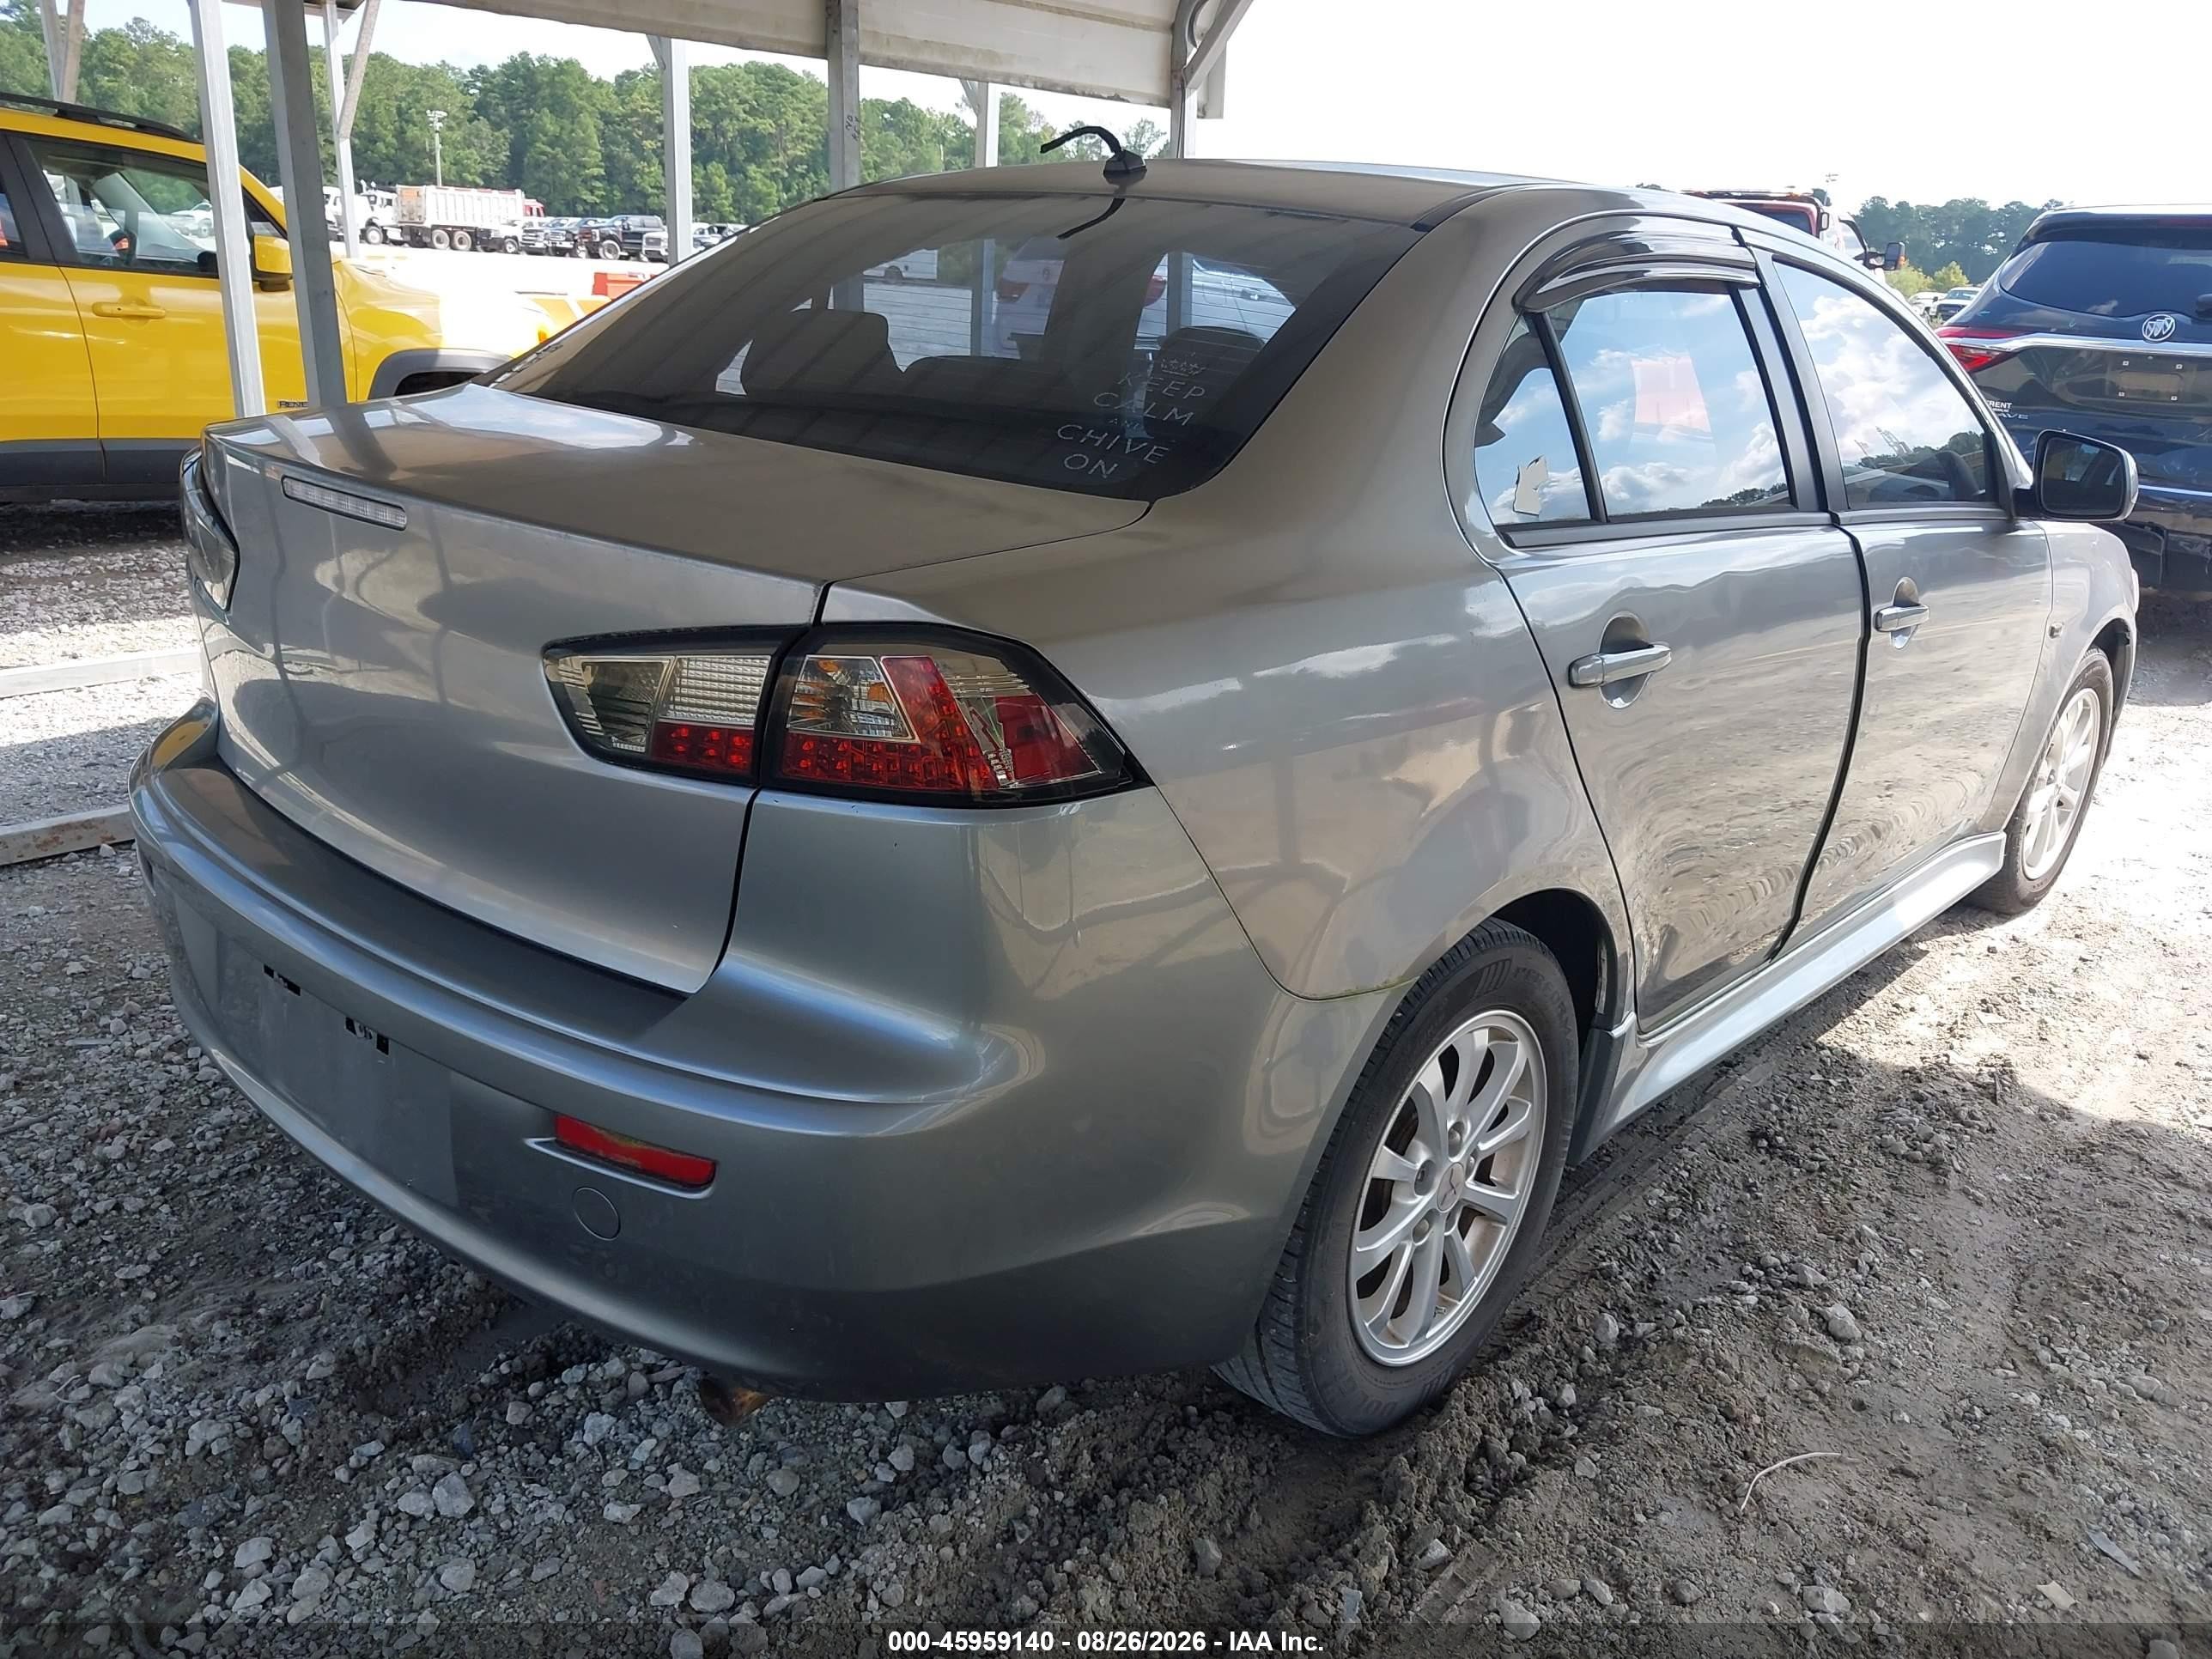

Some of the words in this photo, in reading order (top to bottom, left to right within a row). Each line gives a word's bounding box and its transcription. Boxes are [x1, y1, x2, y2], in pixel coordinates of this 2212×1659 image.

[1117, 371, 1206, 399] KEEP
[1093, 392, 1194, 427] CALM
[1057, 424, 1169, 465] CHIVE
[1064, 453, 1119, 479] ON
